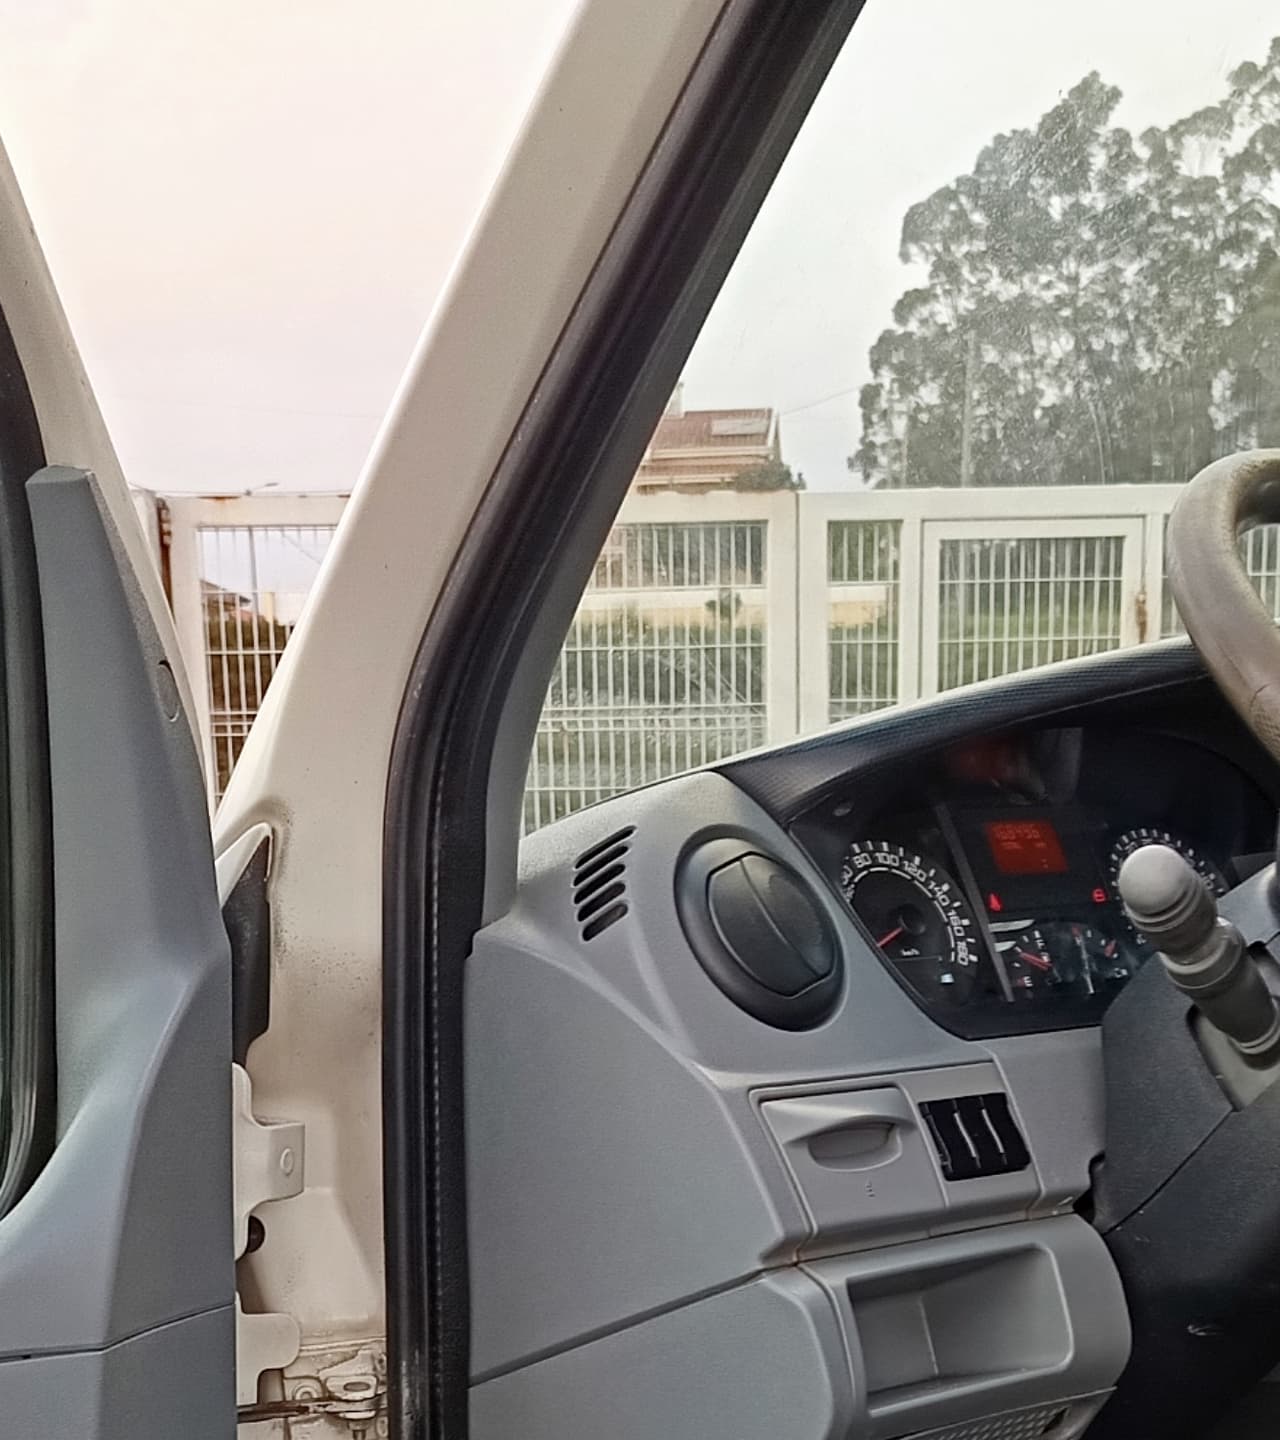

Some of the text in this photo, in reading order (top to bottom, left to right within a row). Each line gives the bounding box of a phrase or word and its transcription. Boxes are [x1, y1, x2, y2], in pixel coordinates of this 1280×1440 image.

[852, 853, 872, 868] 80
[875, 852, 900, 867] 100
[902, 860, 928, 883] 120
[927, 881, 951, 907] 140
[947, 910, 966, 938] 160
[956, 941, 970, 967] 180
